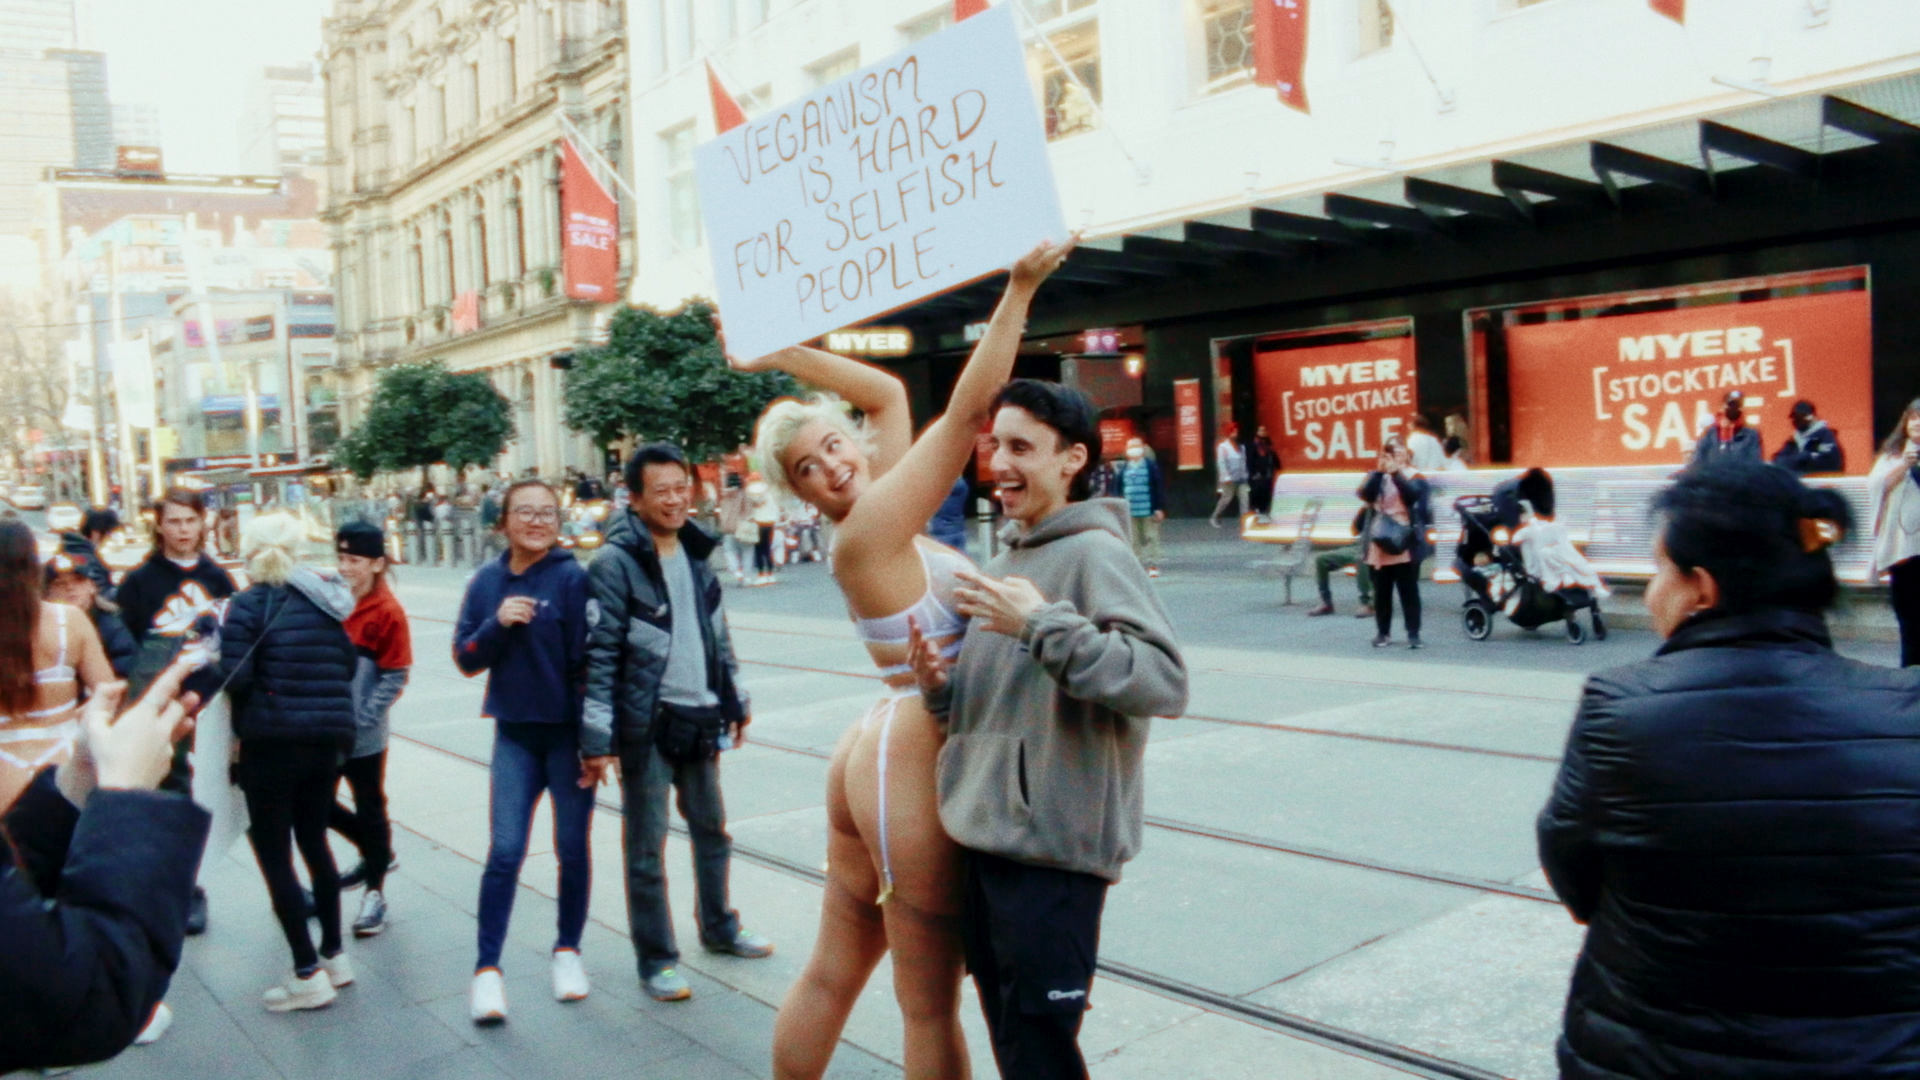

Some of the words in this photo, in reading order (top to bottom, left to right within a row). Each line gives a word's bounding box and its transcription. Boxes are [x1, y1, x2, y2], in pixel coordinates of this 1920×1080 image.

[724, 55, 922, 184] VEGANISM
[799, 156, 833, 207] IS
[849, 90, 987, 182] HARD
[734, 219, 801, 291] FOR
[825, 141, 1005, 252] SELFISH
[571, 231, 609, 250] SALE
[796, 227, 955, 322] PEOPLE.
[828, 332, 907, 351] MYER
[1619, 326, 1763, 363] MYER
[1300, 359, 1401, 387] MYER
[1609, 356, 1778, 402] STOCKTAKE
[1294, 384, 1411, 420] STOCKTAKE
